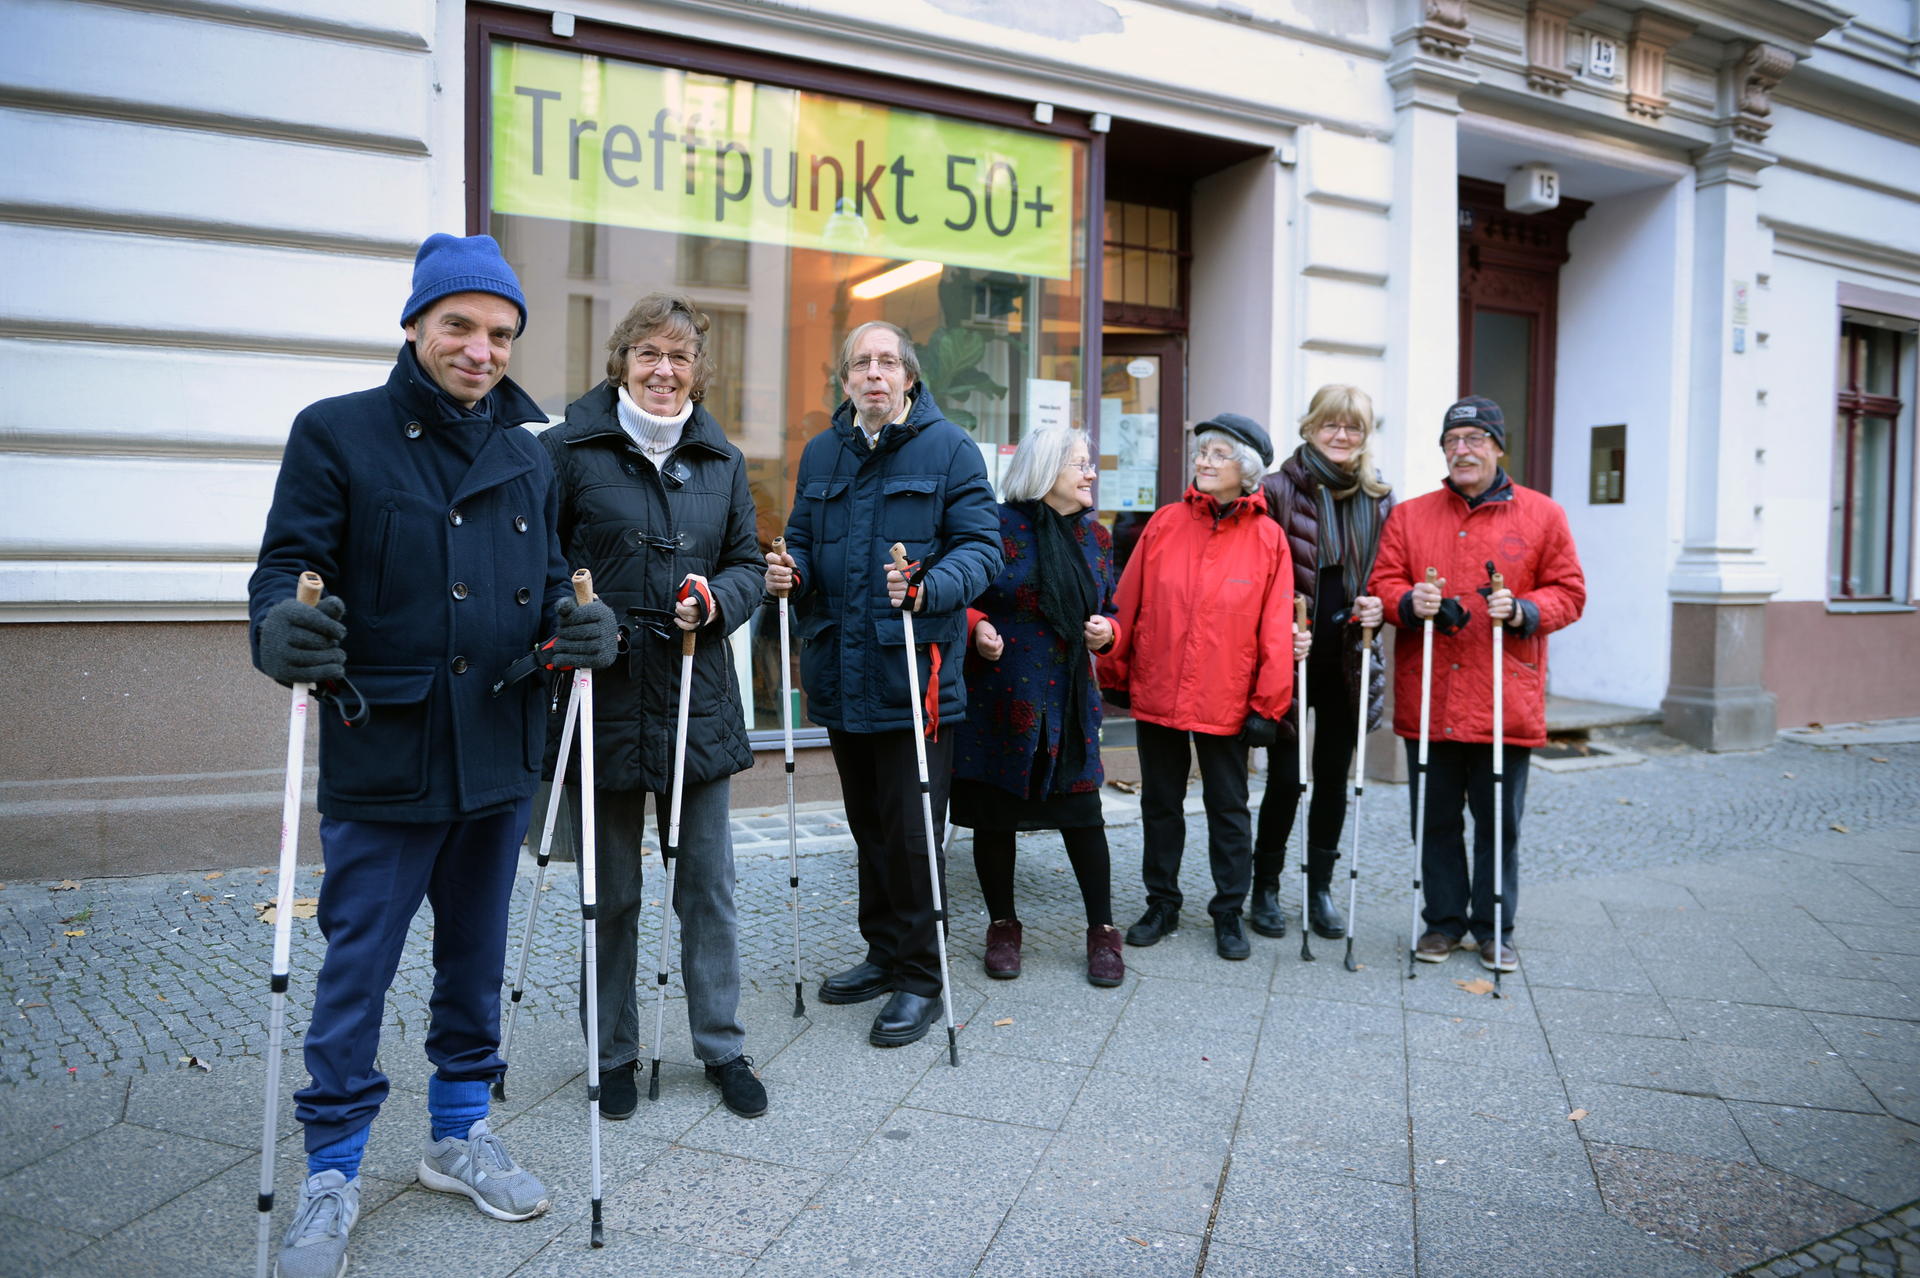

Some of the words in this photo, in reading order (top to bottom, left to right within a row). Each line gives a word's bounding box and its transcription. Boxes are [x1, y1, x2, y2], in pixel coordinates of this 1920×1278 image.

[514, 85, 919, 226] Treffpunkt
[944, 154, 1054, 237] 50+
[1540, 173, 1555, 199] 15
